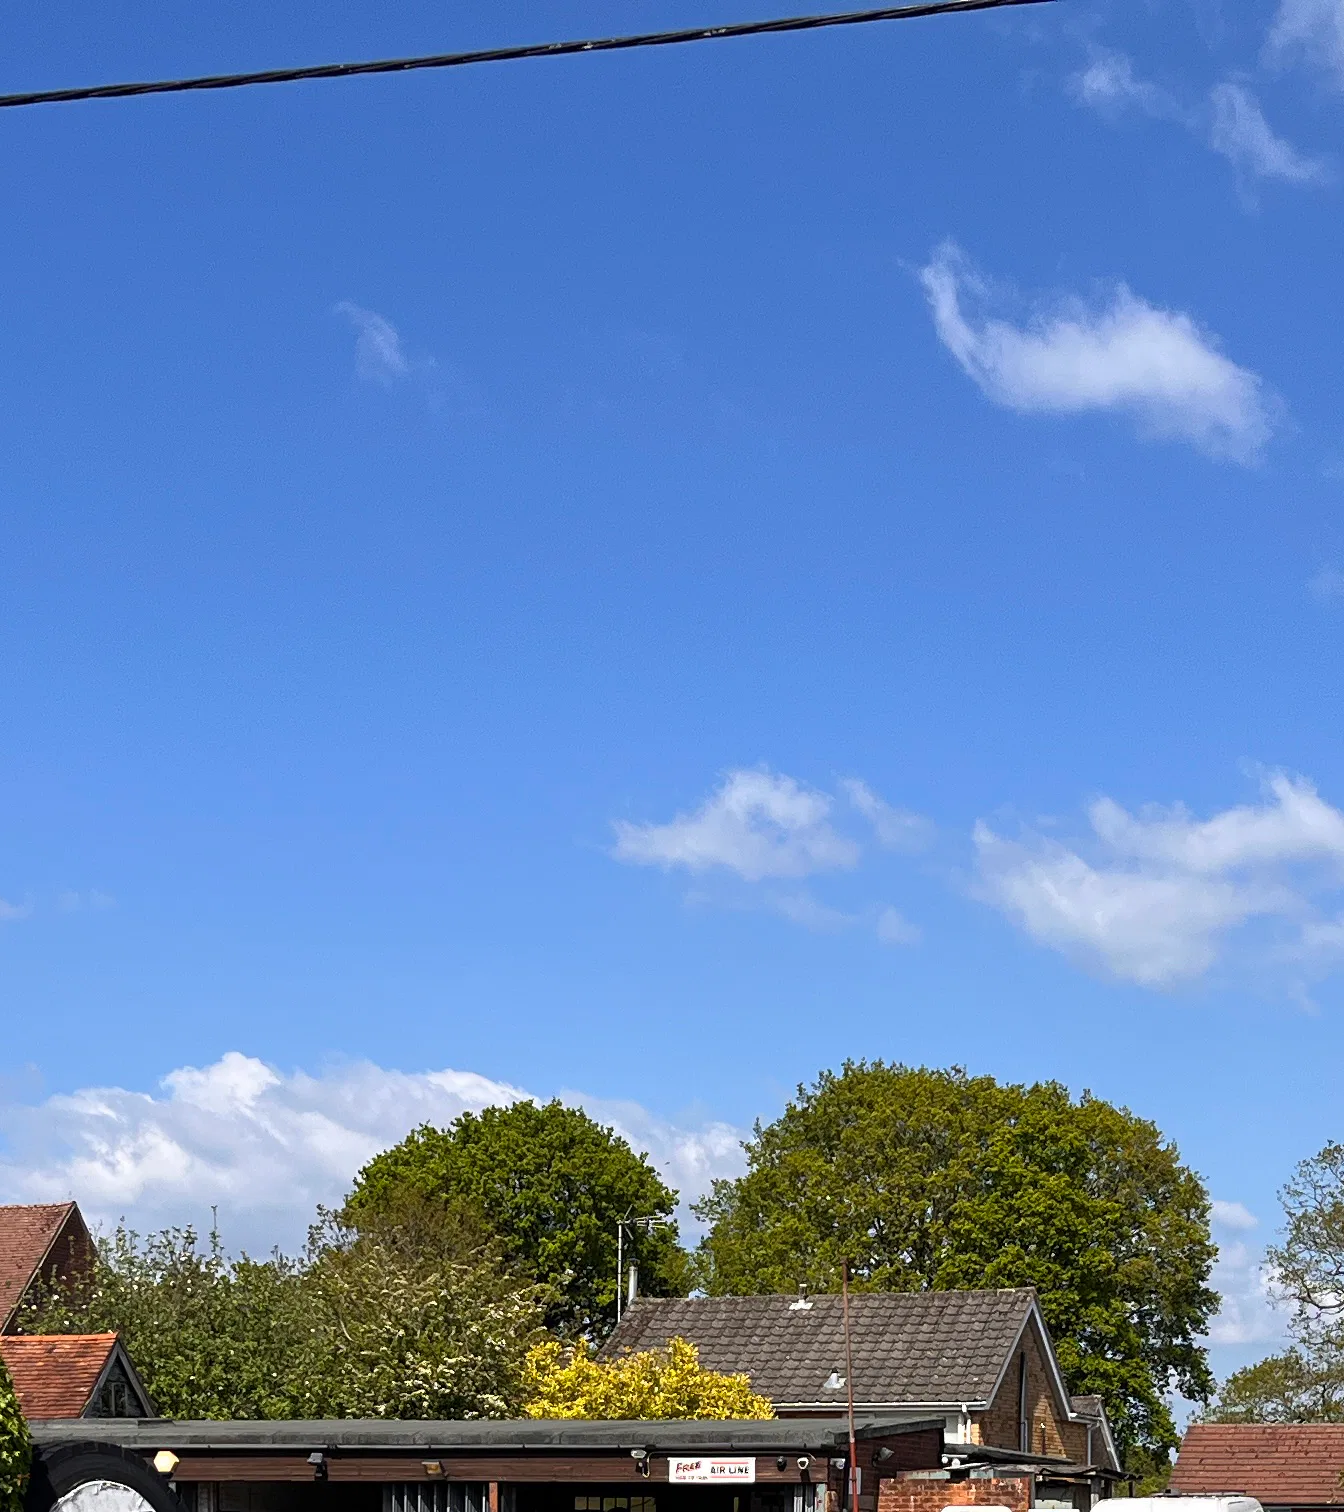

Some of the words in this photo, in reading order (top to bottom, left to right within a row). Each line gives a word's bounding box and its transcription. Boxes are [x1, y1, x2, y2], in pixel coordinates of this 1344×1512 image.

[675, 1461, 702, 1474] FREE
[710, 1466, 726, 1474] AIR
[728, 1466, 750, 1474] LINE
